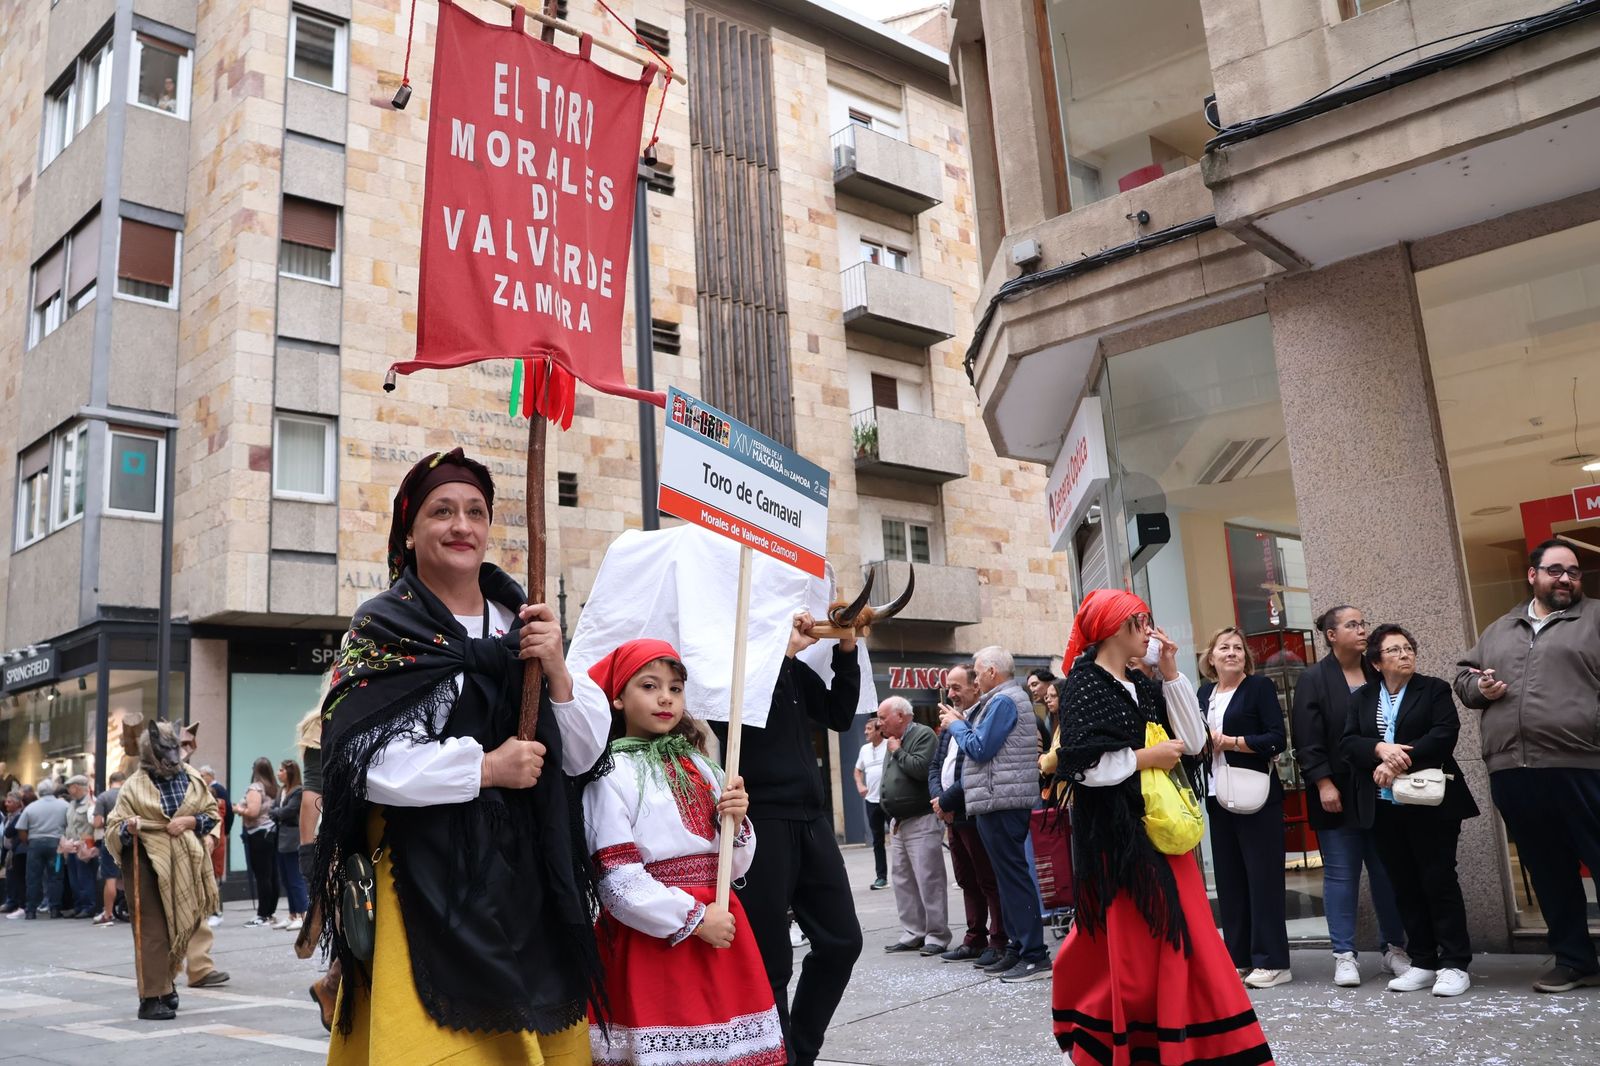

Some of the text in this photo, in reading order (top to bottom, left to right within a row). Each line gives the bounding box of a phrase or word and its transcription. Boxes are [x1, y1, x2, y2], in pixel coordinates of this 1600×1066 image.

[494, 61, 594, 151] EL TORO
[451, 118, 614, 211] MORALES
[443, 206, 613, 299] VALVERDE
[493, 274, 592, 333] ZAMORA
[733, 430, 754, 457] XIV
[702, 462, 802, 528] Toro de Carnaval
[789, 471, 811, 489] ZAMORA
[701, 509, 798, 562] Morales de Valverde (Zamora)
